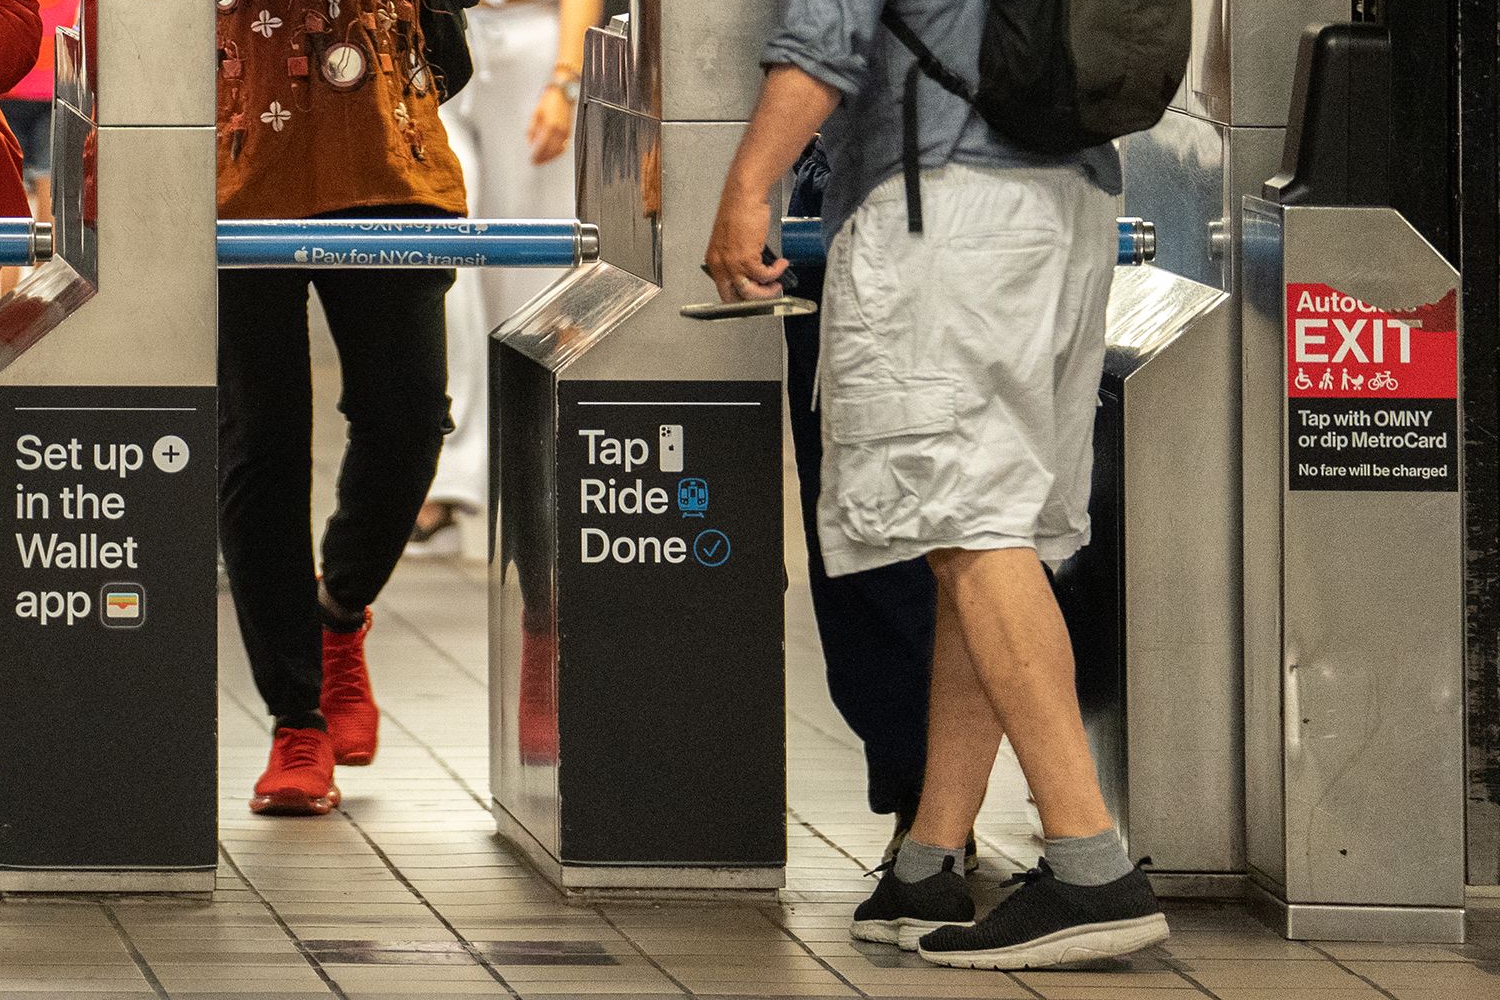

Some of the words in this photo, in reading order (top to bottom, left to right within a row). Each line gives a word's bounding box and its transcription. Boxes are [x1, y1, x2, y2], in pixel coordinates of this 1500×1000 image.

[312, 248, 346, 265] Pay
[350, 249, 376, 264] for
[380, 249, 423, 265] NYC
[426, 252, 487, 266] transit
[1295, 318, 1423, 364] EXIT
[1298, 410, 1331, 430] Tap
[1333, 410, 1371, 427] with
[1373, 410, 1433, 427] OMNY
[15, 434, 83, 471] Set
[93, 442, 144, 478] up
[578, 429, 649, 473] Tap
[1298, 434, 1318, 448] or
[1319, 432, 1349, 451] dip
[1351, 432, 1448, 449] MetroCard
[1298, 463, 1319, 477] No
[1320, 464, 1347, 477] fare
[1348, 464, 1371, 477] will
[1372, 464, 1391, 478] be
[1393, 464, 1448, 480] charged
[16, 483, 49, 519] in
[59, 484, 126, 520] the
[580, 478, 669, 514] Ride
[15, 532, 138, 569] Wallet
[581, 527, 688, 564] Done
[15, 590, 92, 626] app
